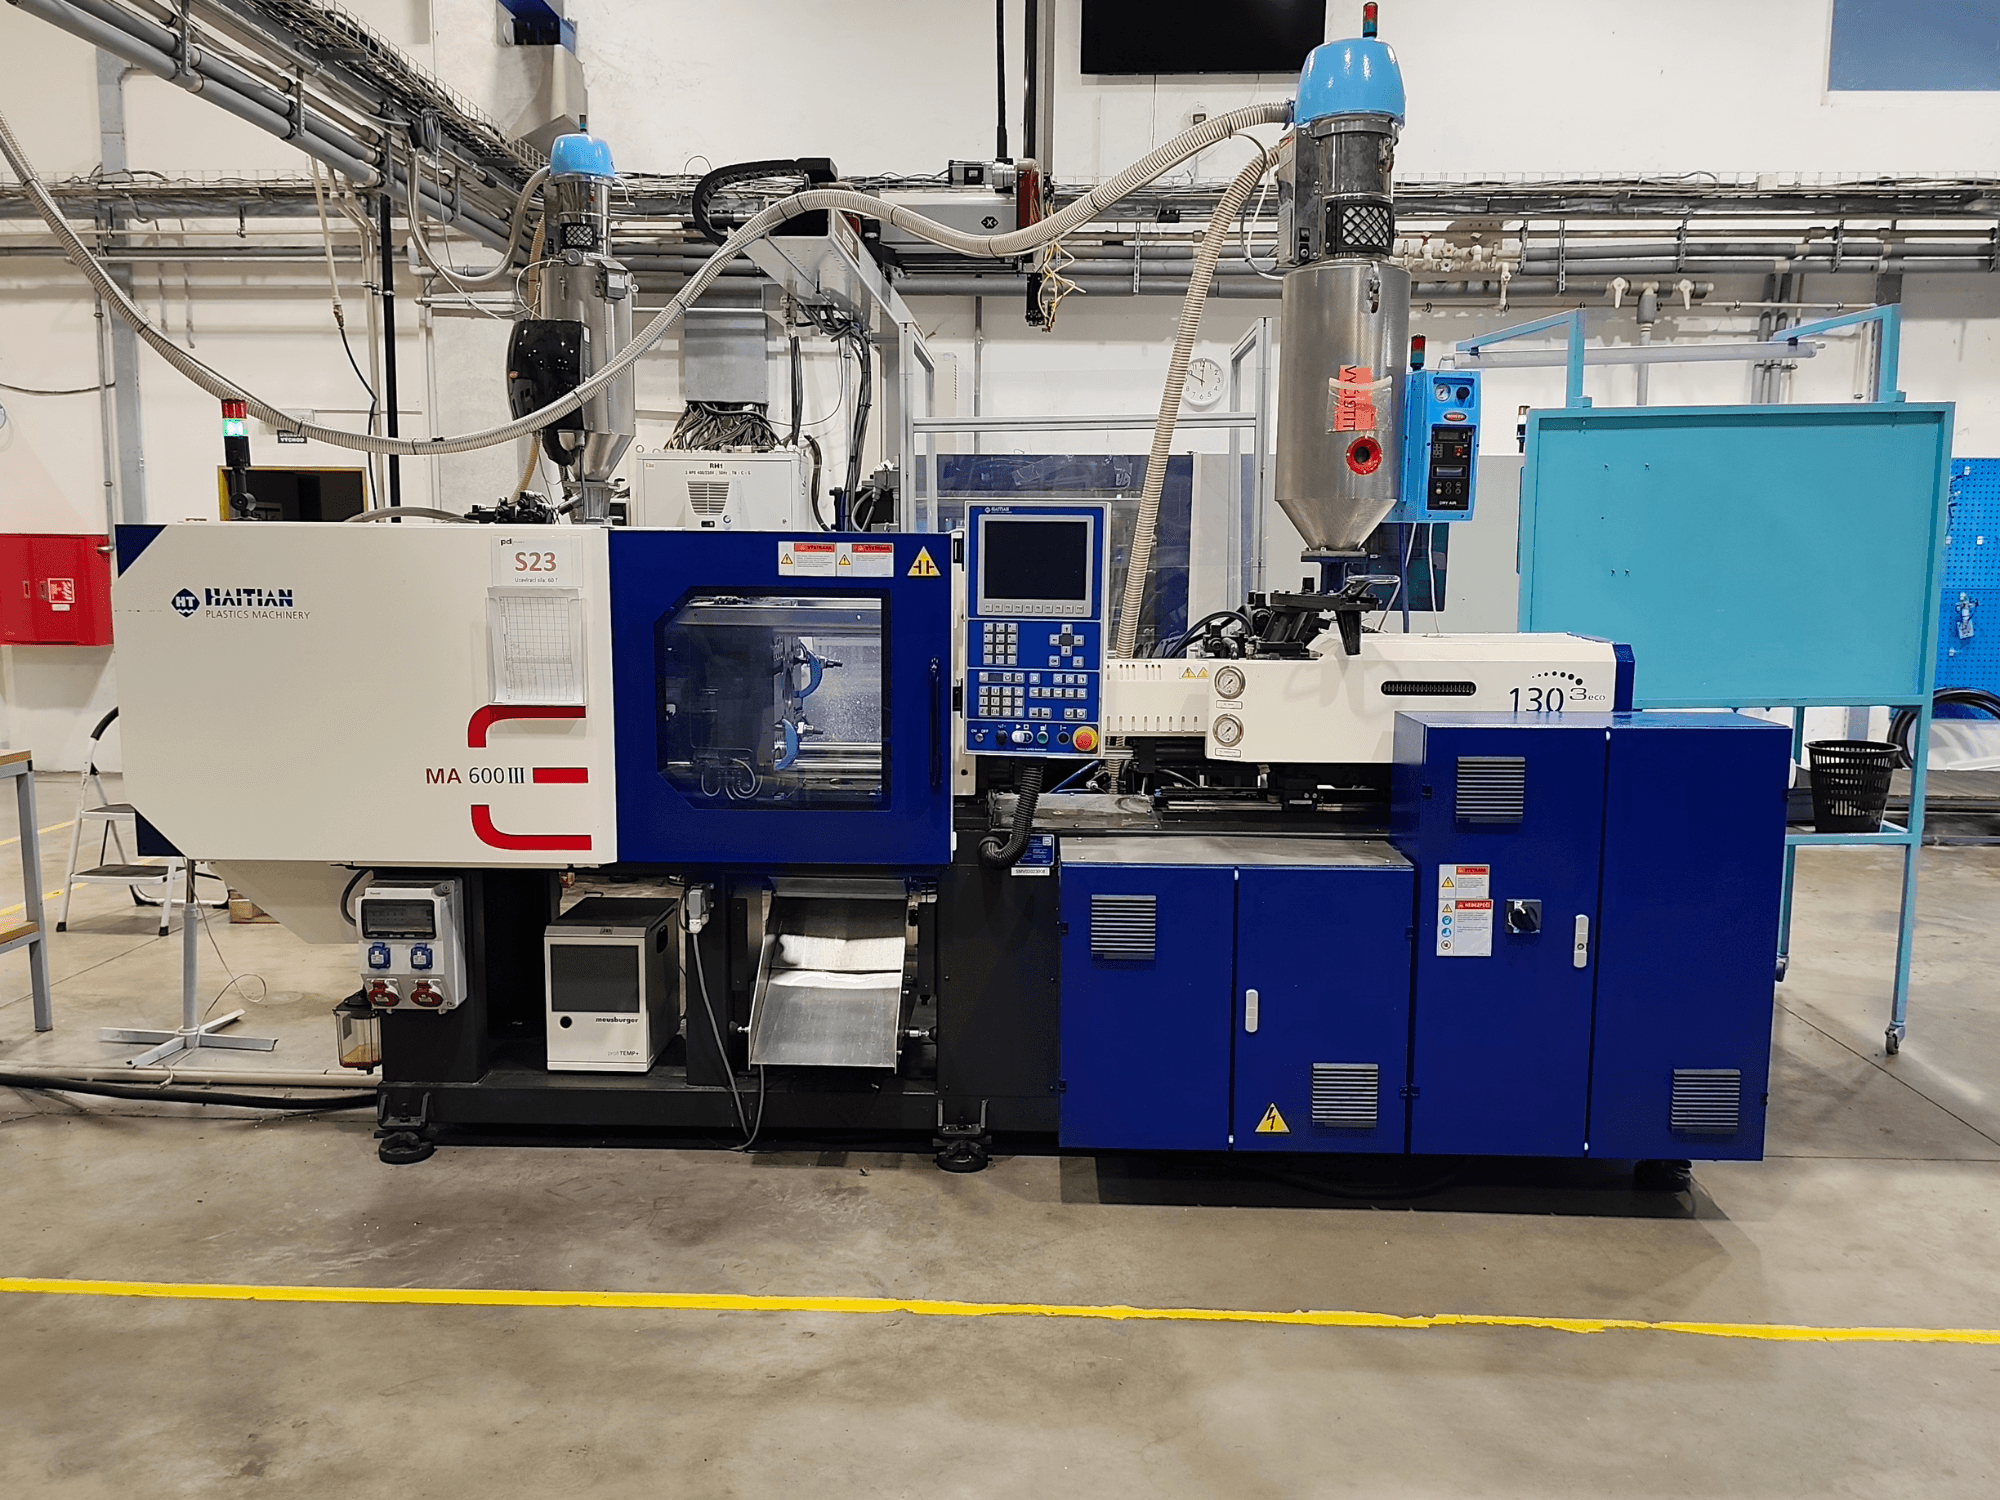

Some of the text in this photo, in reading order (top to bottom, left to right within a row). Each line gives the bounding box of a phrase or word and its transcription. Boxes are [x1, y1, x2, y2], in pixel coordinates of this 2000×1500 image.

[515, 551, 557, 572] S23
[175, 596, 196, 608] HT
[205, 588, 293, 608] HAITIAN
[206, 610, 310, 620] PLASTICS MACHINERY
[1509, 687, 1564, 712] 130
[426, 768, 462, 784] MA
[595, 1016, 639, 1024] meusburger
